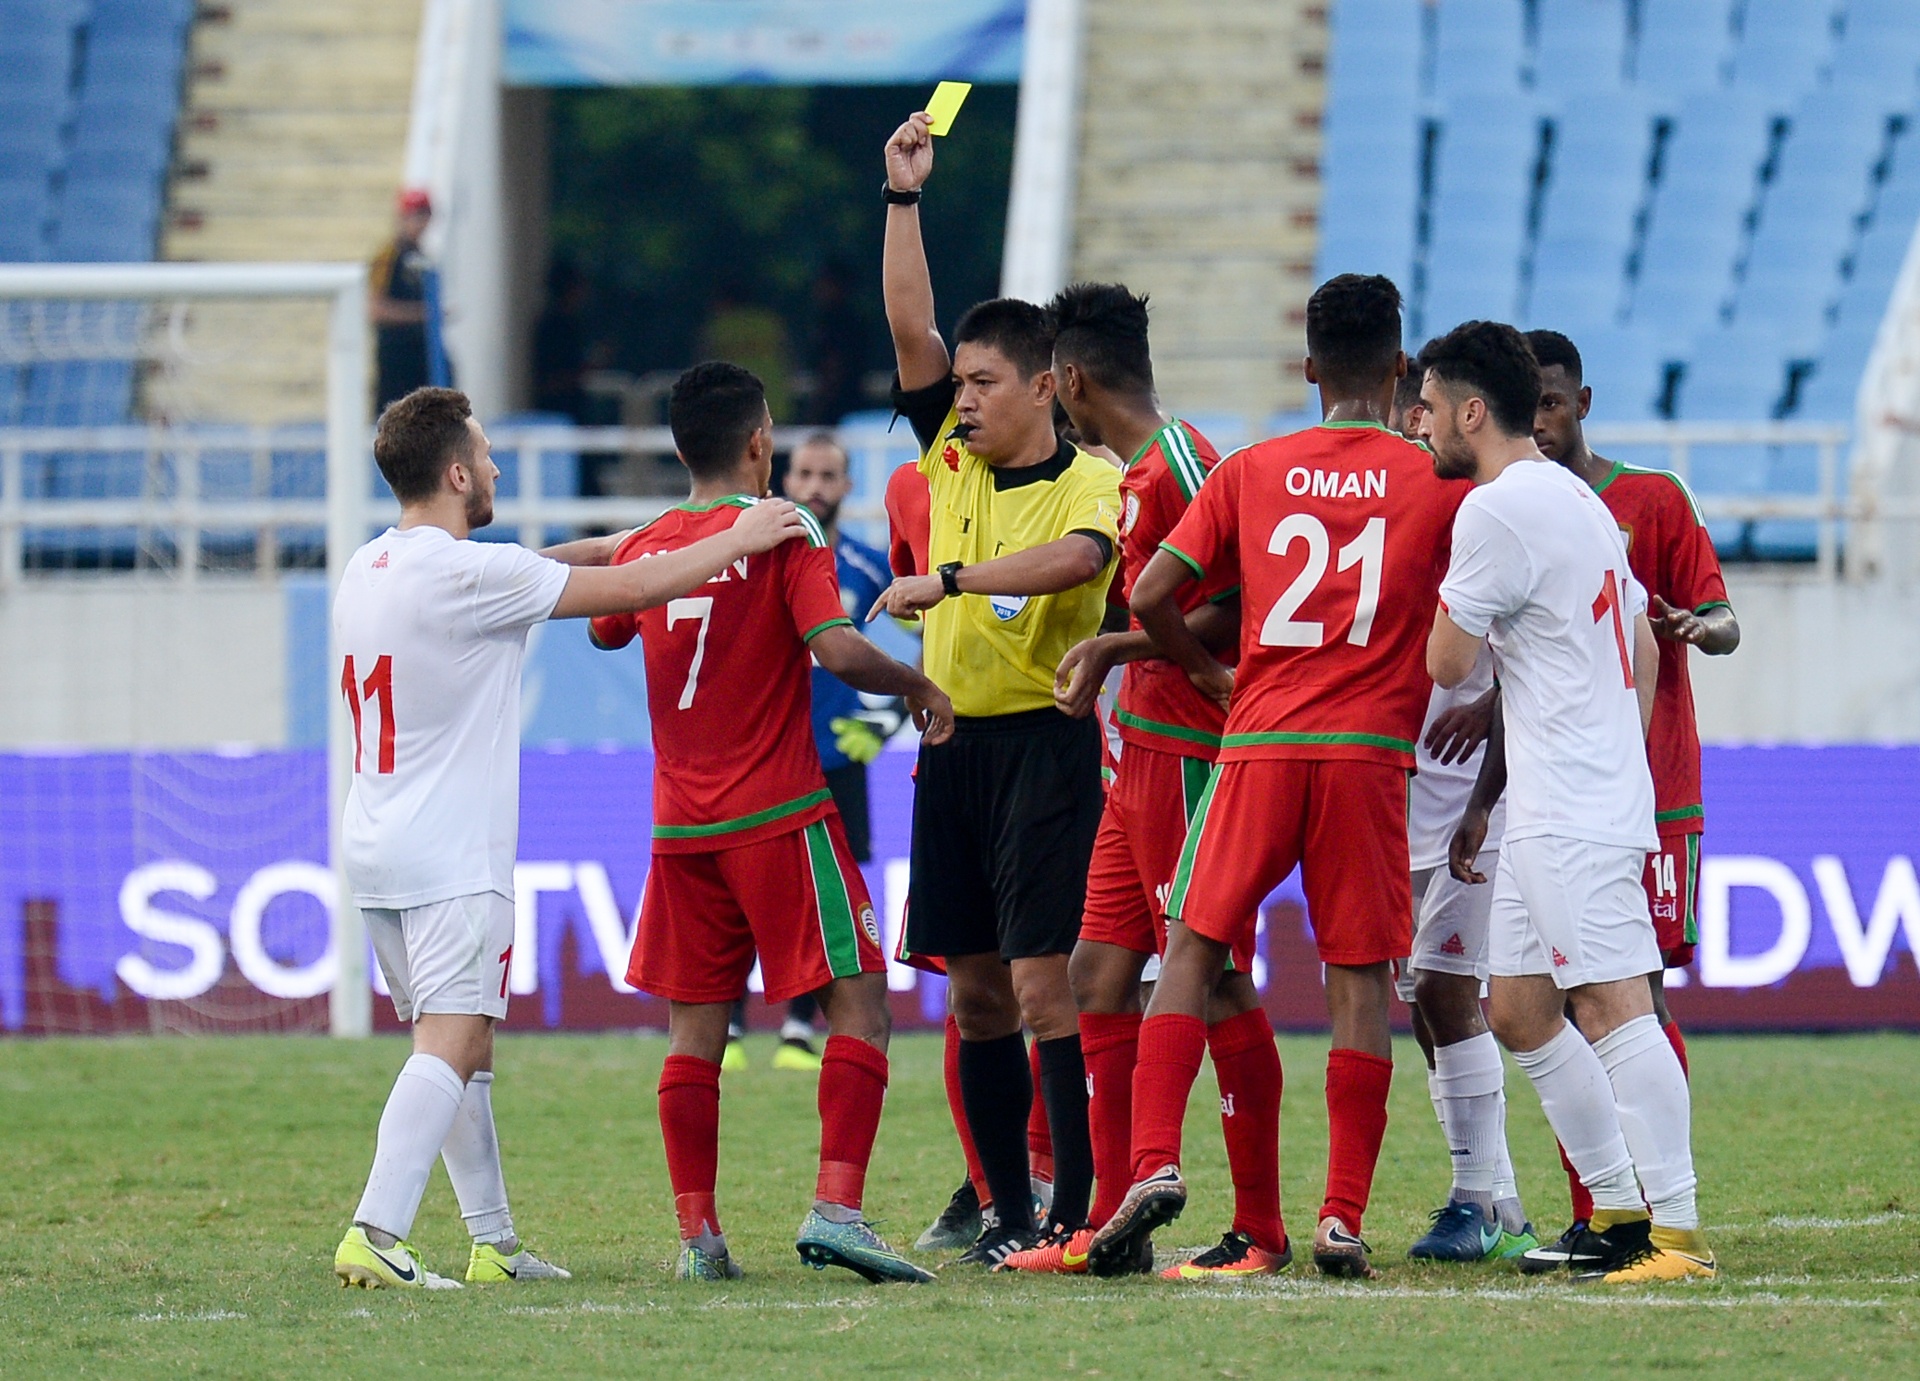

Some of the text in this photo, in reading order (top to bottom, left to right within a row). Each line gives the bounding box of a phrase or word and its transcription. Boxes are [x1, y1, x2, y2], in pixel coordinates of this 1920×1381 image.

[1285, 467, 1387, 498] OMAN
[1259, 513, 1386, 647] 21
[667, 597, 713, 710] 7
[341, 654, 396, 774] 11
[1651, 854, 1677, 897] 14
